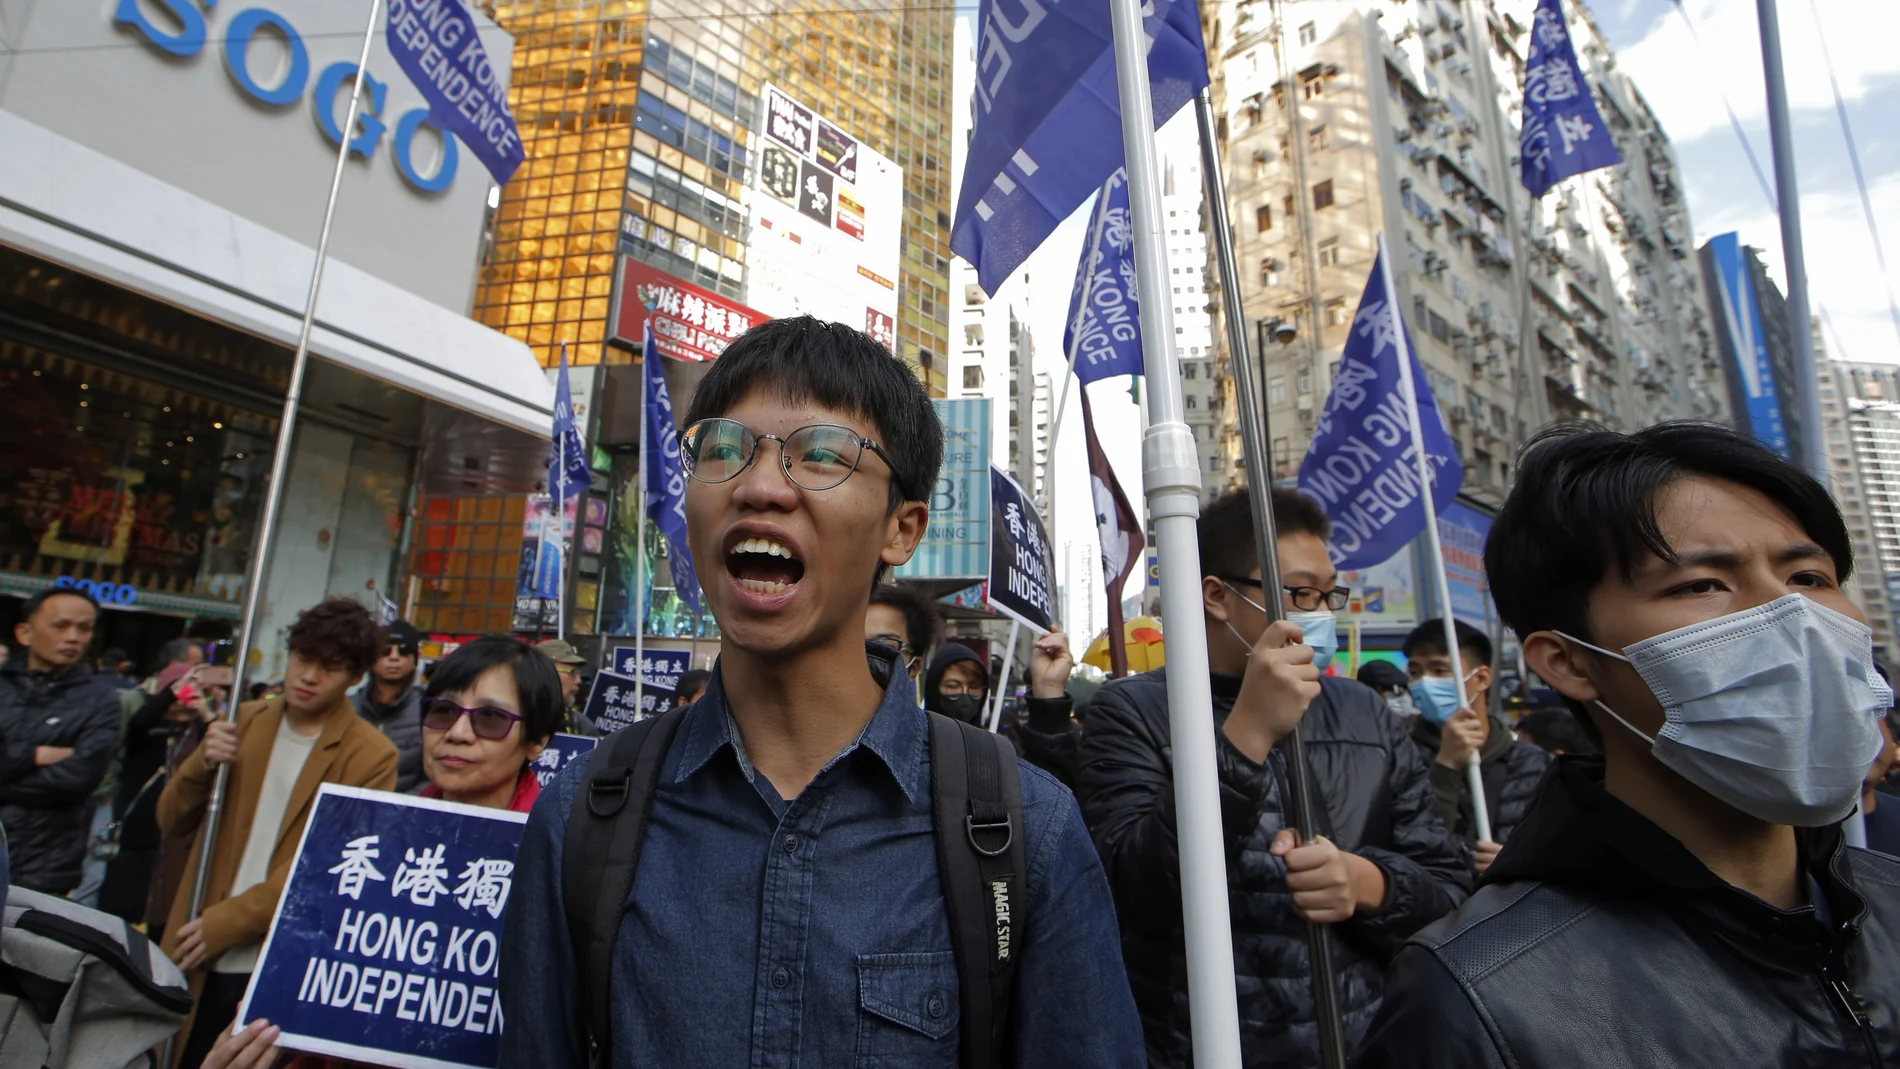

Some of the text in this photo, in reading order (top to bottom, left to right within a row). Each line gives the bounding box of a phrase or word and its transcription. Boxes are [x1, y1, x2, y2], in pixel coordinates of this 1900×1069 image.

[114, 0, 458, 192] SOGO
[1094, 268, 1136, 342] KONG
[922, 527, 967, 539] INING
[1015, 542, 1046, 585] HONG
[604, 705, 634, 722] HONG
[327, 834, 515, 919] 香港獨
[334, 908, 439, 966] HONG
[992, 881, 1011, 960] MAGIC STAR
